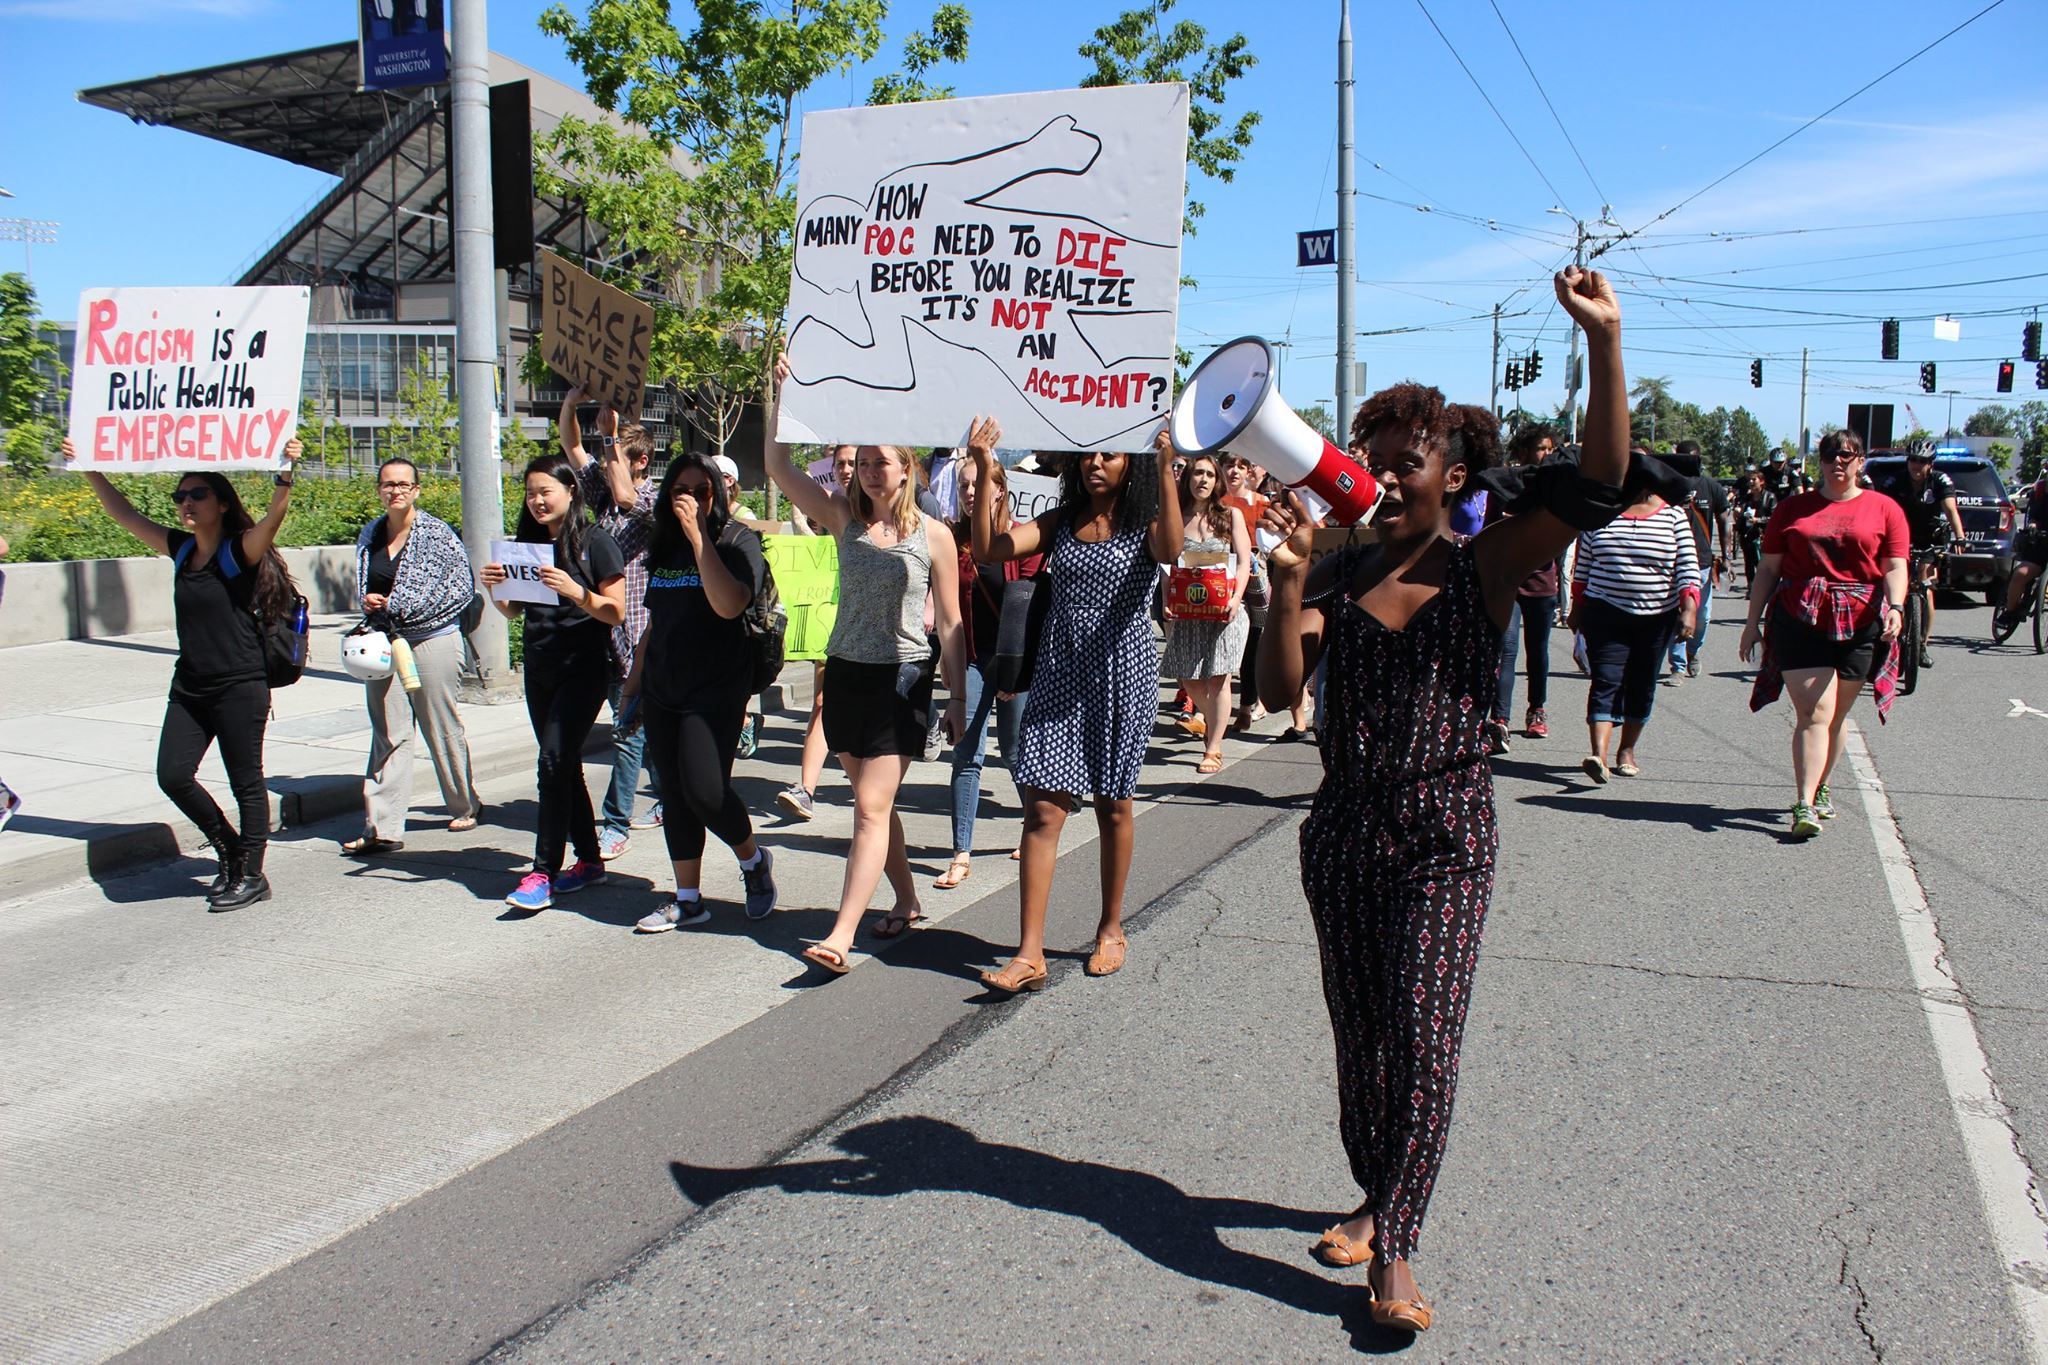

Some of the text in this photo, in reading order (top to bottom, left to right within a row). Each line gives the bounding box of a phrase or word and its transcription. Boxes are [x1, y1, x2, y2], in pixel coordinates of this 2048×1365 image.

[374, 58, 431, 76] WASHINGTON
[378, 48, 427, 63] UNIVERSITY of
[875, 183, 928, 221] HOW
[803, 215, 863, 247] MANY
[933, 224, 994, 256] NEED
[1055, 228, 1127, 277] DIE
[1303, 235, 1331, 260] W
[871, 258, 1135, 307] BEFORE YOU REALIZE
[85, 299, 267, 365] Racism is a
[552, 265, 648, 362] BLACK
[921, 294, 1052, 330] IT'S NOT
[556, 309, 641, 389] LIVES
[1017, 333, 1056, 360] AN
[108, 362, 255, 411] Public Health
[551, 341, 638, 416] MATTER
[1023, 367, 1168, 411] ACCIDENT?
[93, 409, 290, 462] EMERGENCY
[1956, 496, 1983, 506] POLICE
[1187, 586, 1207, 602] RITZ
